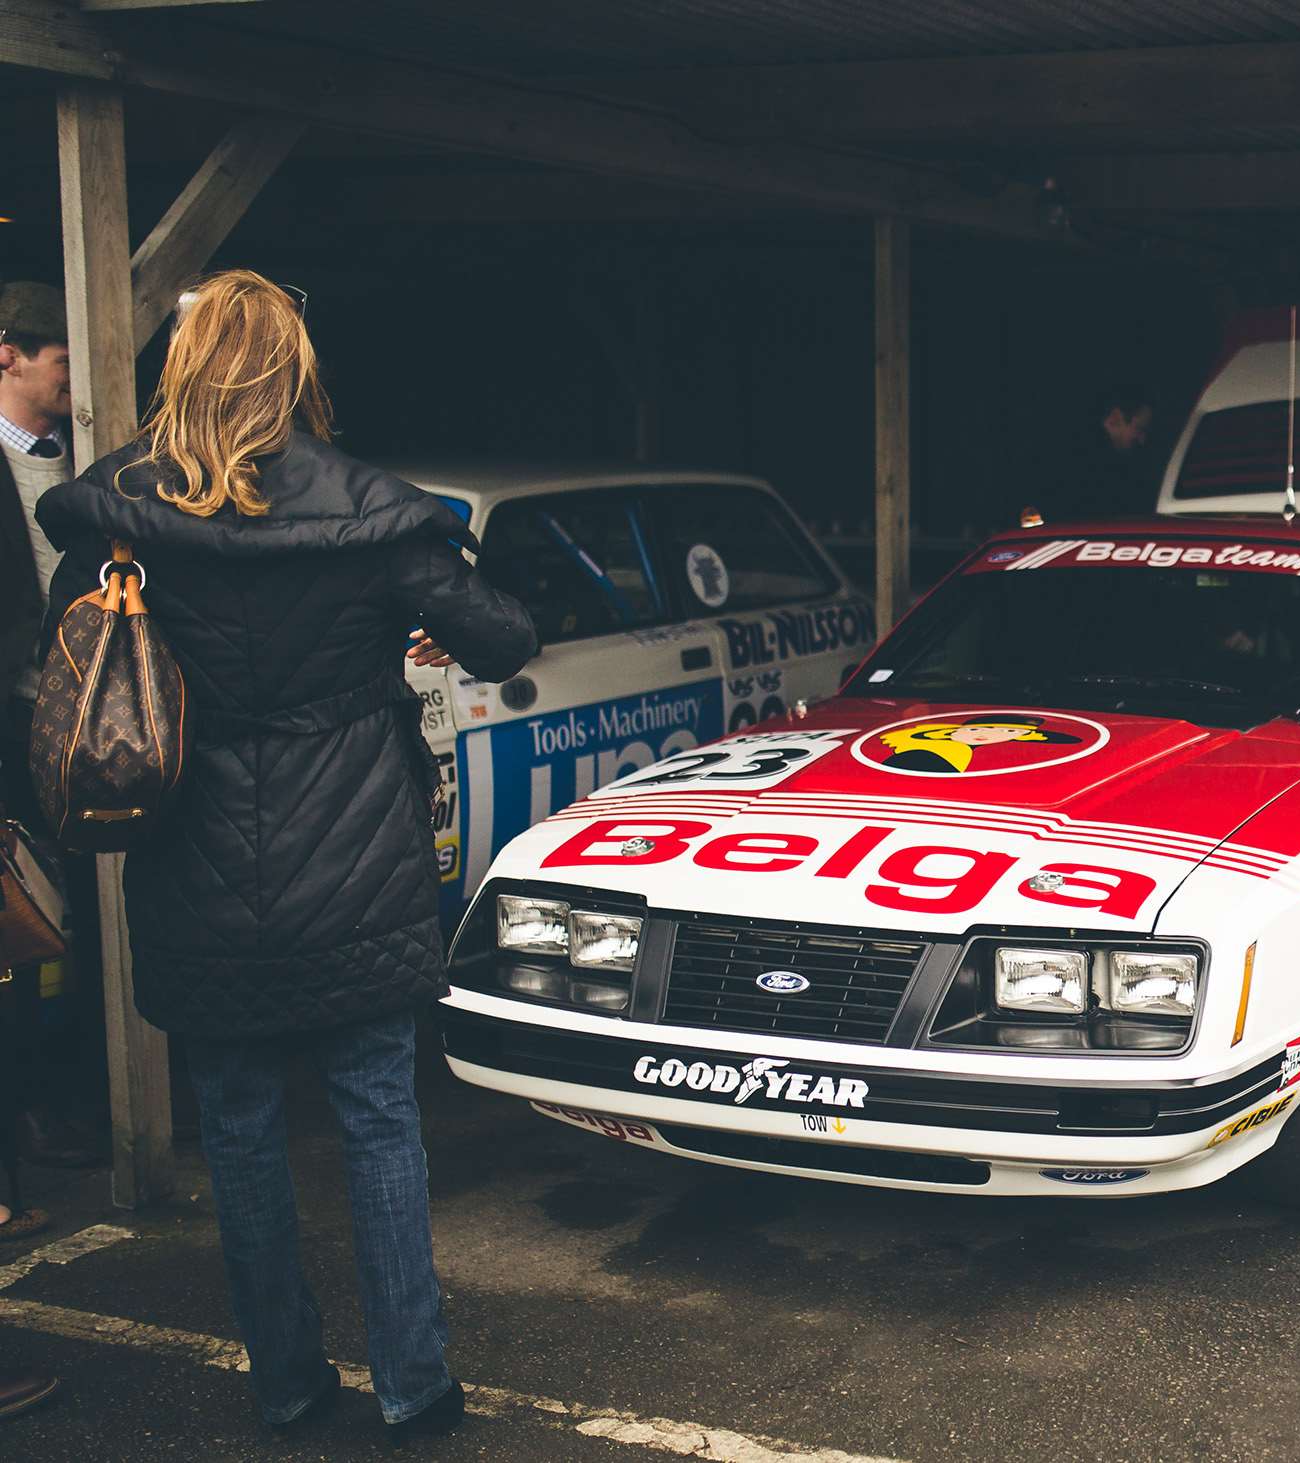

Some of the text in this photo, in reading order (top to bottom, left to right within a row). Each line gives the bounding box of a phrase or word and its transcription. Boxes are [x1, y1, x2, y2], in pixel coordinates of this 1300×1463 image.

[1076, 541, 1212, 567] Belga
[419, 688, 443, 708] RG
[528, 712, 587, 756] Tools
[599, 695, 698, 740] Machinery
[608, 752, 809, 790] 23
[540, 819, 1157, 919] Belga
[764, 973, 800, 990] Ford
[535, 1099, 655, 1142] elga
[800, 1115, 828, 1133] TOW
